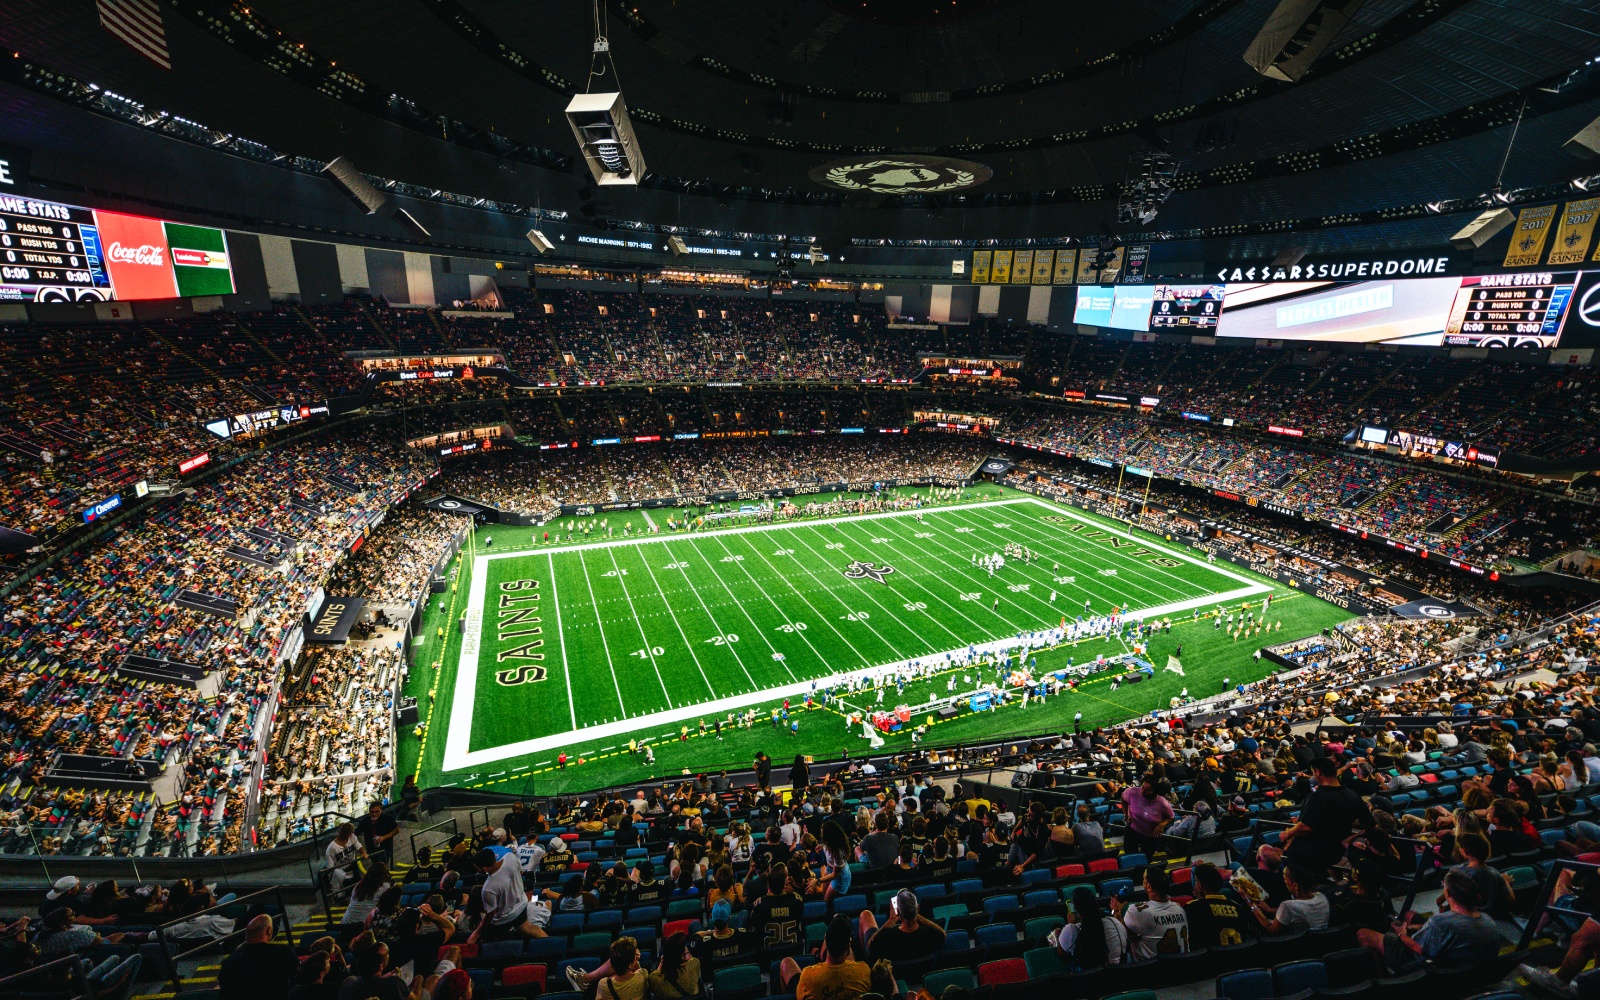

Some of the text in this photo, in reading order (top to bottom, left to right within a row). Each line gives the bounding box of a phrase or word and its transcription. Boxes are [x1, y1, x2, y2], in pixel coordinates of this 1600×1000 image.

[0, 159, 14, 184] E
[27, 202, 70, 220] STATS
[1522, 220, 1545, 230] 2011
[1566, 213, 1594, 225] 2017
[16, 223, 38, 232] PASS
[38, 226, 54, 234] YDS
[62, 227, 71, 238] 0
[2, 234, 75, 252] 0 RUSH YDS 0
[599, 238, 624, 246] MANNING
[628, 242, 652, 250] 1971-1982
[6, 250, 78, 266] 0 TOTAL YDS 0
[108, 242, 164, 266] Coca-Cola
[1550, 256, 1583, 264] SAINTS
[1318, 257, 1449, 278] SUPERDOME
[1506, 258, 1536, 266] SAINTS
[2, 266, 30, 279] 0:00
[66, 270, 90, 282] 0:00
[1480, 273, 1552, 286] GAME STATS
[1480, 291, 1488, 300] 0
[1536, 289, 1544, 299] 0
[1161, 302, 1214, 312] 0 0
[1280, 287, 1390, 322] PEOPLES HEALTH
[1476, 301, 1484, 310] 0
[1532, 300, 1540, 310] 0
[1474, 312, 1481, 320] 0
[1528, 312, 1536, 320] 0
[1463, 323, 1484, 332] 0:00
[1516, 323, 1540, 332] 0:00
[233, 422, 240, 430] 0
[1478, 453, 1497, 462] TOYOTA
[794, 486, 820, 494] SAINTS
[1015, 484, 1032, 493] SAINTS
[676, 496, 706, 505] SAINTS
[1054, 496, 1072, 505] SAINTS
[1214, 490, 1240, 501] verizon
[96, 498, 118, 515] Chevron
[1264, 503, 1295, 516] CAESARS
[542, 510, 562, 523] SAINTS
[56, 516, 76, 534] SAINTS
[1142, 524, 1164, 536] SAINTS
[1040, 515, 1185, 568] SAINTS
[1192, 542, 1218, 556] SAINTS
[1260, 538, 1342, 570] SUPERDOME
[607, 568, 629, 576] 10
[1250, 564, 1278, 579] SAINTS
[1008, 584, 1030, 592] 30
[960, 592, 981, 601] 40
[1316, 590, 1348, 608] SAINTS
[903, 602, 928, 612] 50
[314, 603, 346, 636] SAINTS
[846, 612, 870, 622] 40
[496, 579, 548, 686] SAINTS
[783, 622, 808, 633] 30
[711, 634, 740, 646] 20
[636, 646, 665, 660] 10
[1235, 776, 1252, 792] 77
[771, 907, 790, 918] BUSH
[1210, 904, 1239, 918] BREES
[1154, 913, 1185, 926] KAMARA
[764, 920, 798, 948] 25
[1156, 925, 1190, 954] 41
[712, 944, 740, 958] GRAHAM
